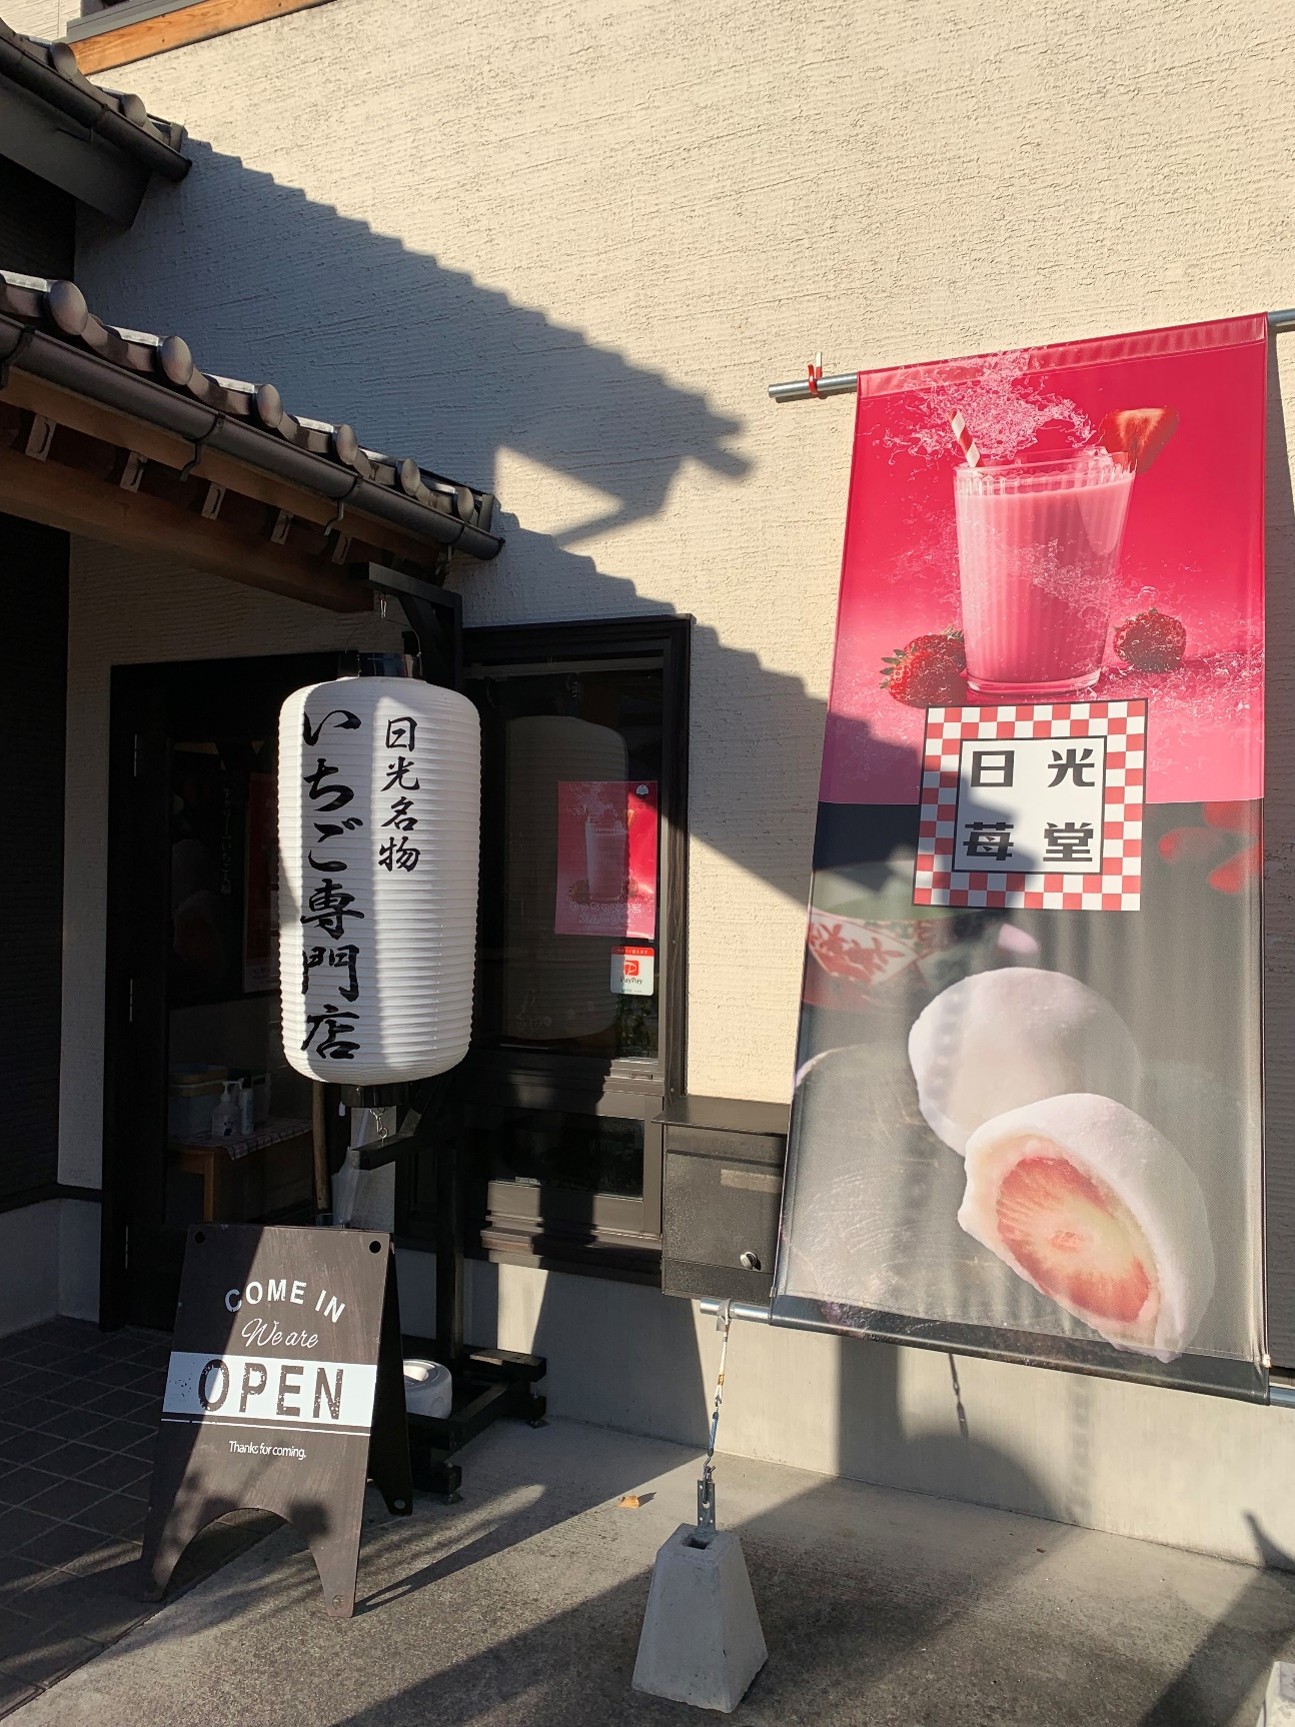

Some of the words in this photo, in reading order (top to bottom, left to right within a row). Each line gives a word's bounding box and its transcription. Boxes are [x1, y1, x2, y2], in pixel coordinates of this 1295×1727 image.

[378, 716, 421, 872] 日光名物
[300, 709, 366, 1060] いちご専門店
[620, 976, 643, 984] PayPay
[224, 1279, 307, 1313] COME
[315, 1290, 346, 1323] IN
[241, 1318, 283, 1348] We
[285, 1329, 319, 1349] are
[198, 1358, 344, 1420] OPEN
[229, 1441, 259, 1454] Thanks
[259, 1442, 272, 1455] for
[272, 1444, 307, 1460] coming.
